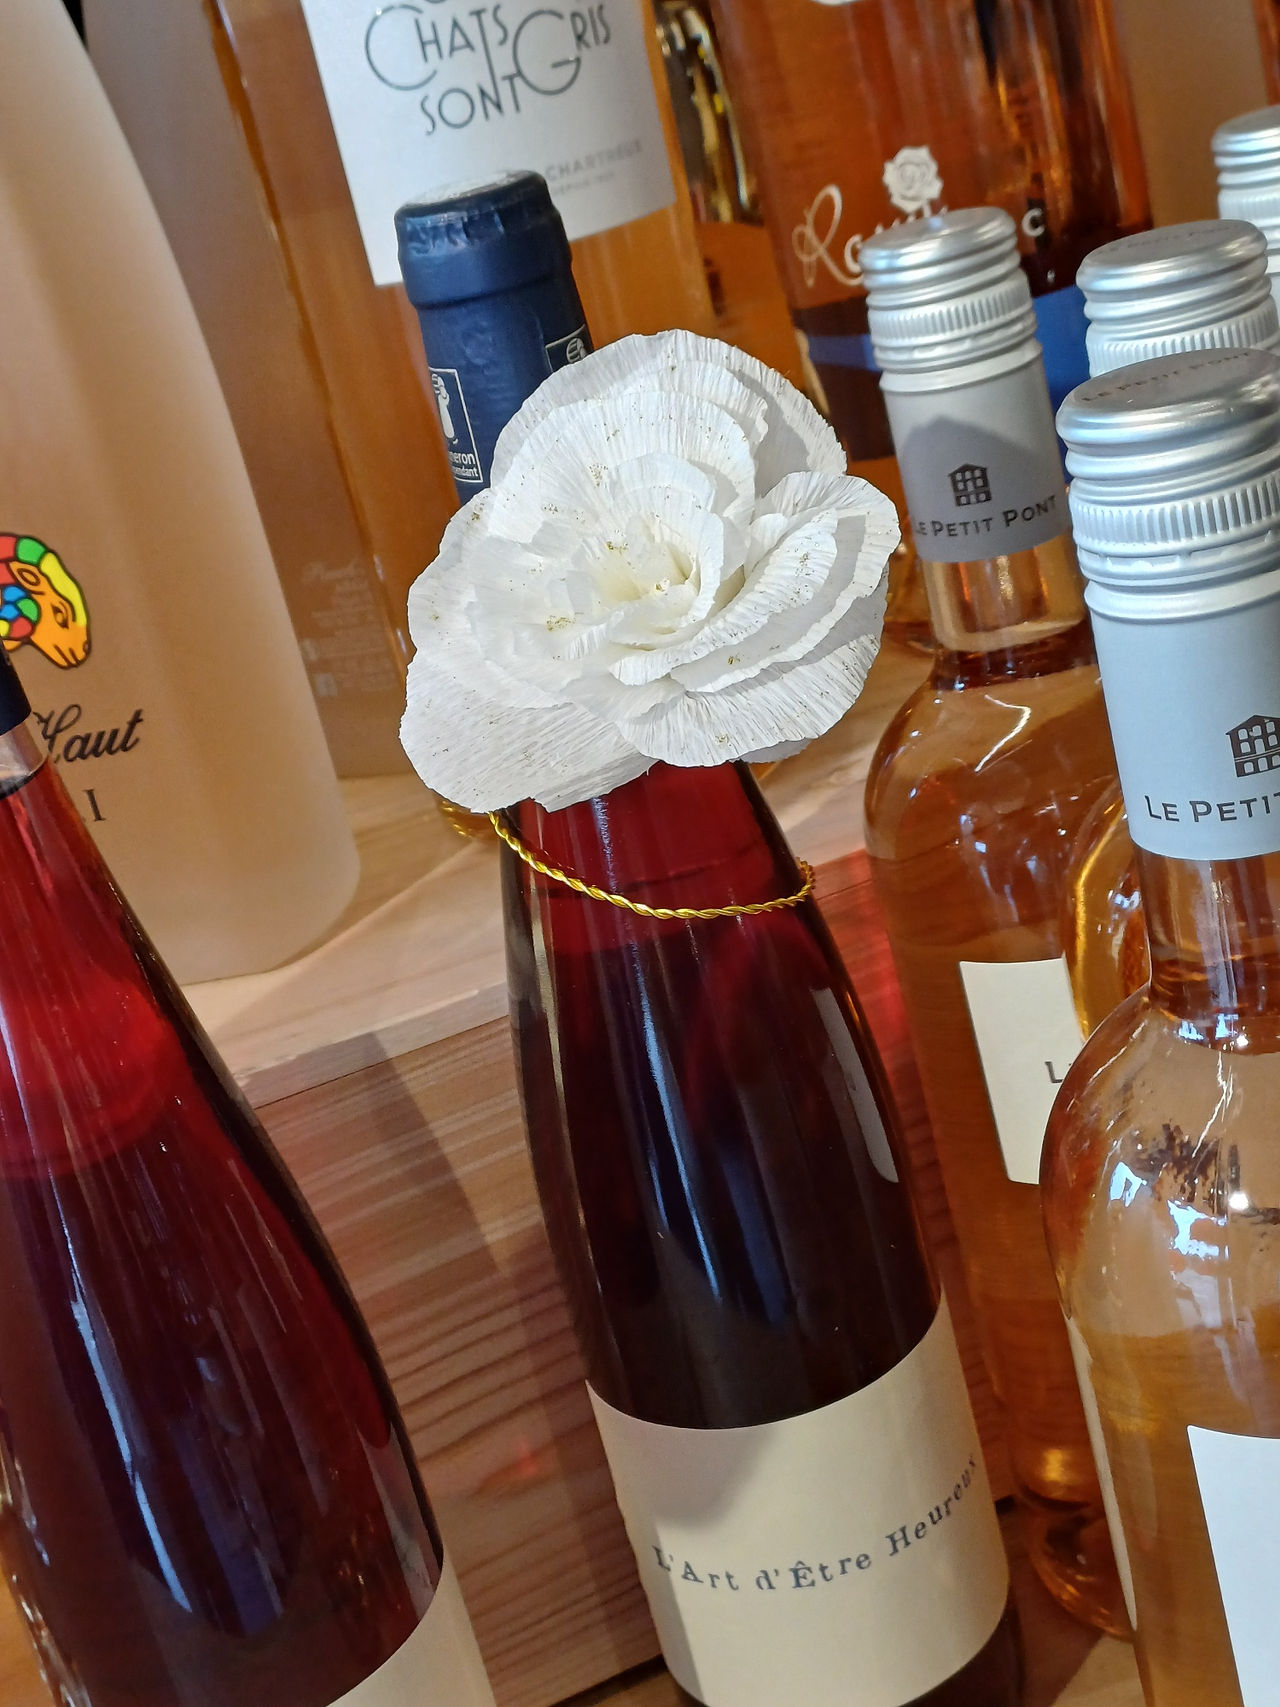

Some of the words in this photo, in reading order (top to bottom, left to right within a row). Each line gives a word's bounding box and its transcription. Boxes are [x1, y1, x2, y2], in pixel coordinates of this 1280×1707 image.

[365, 4, 508, 94] CHATS
[512, 4, 611, 96] GRIS
[420, 72, 521, 136] SONT
[931, 517, 994, 537] PETIT
[1002, 495, 1056, 529] PONT
[1145, 795, 1180, 822] LE
[653, 1546, 739, 1591] L'Art
[755, 1553, 872, 1591] d'Être
